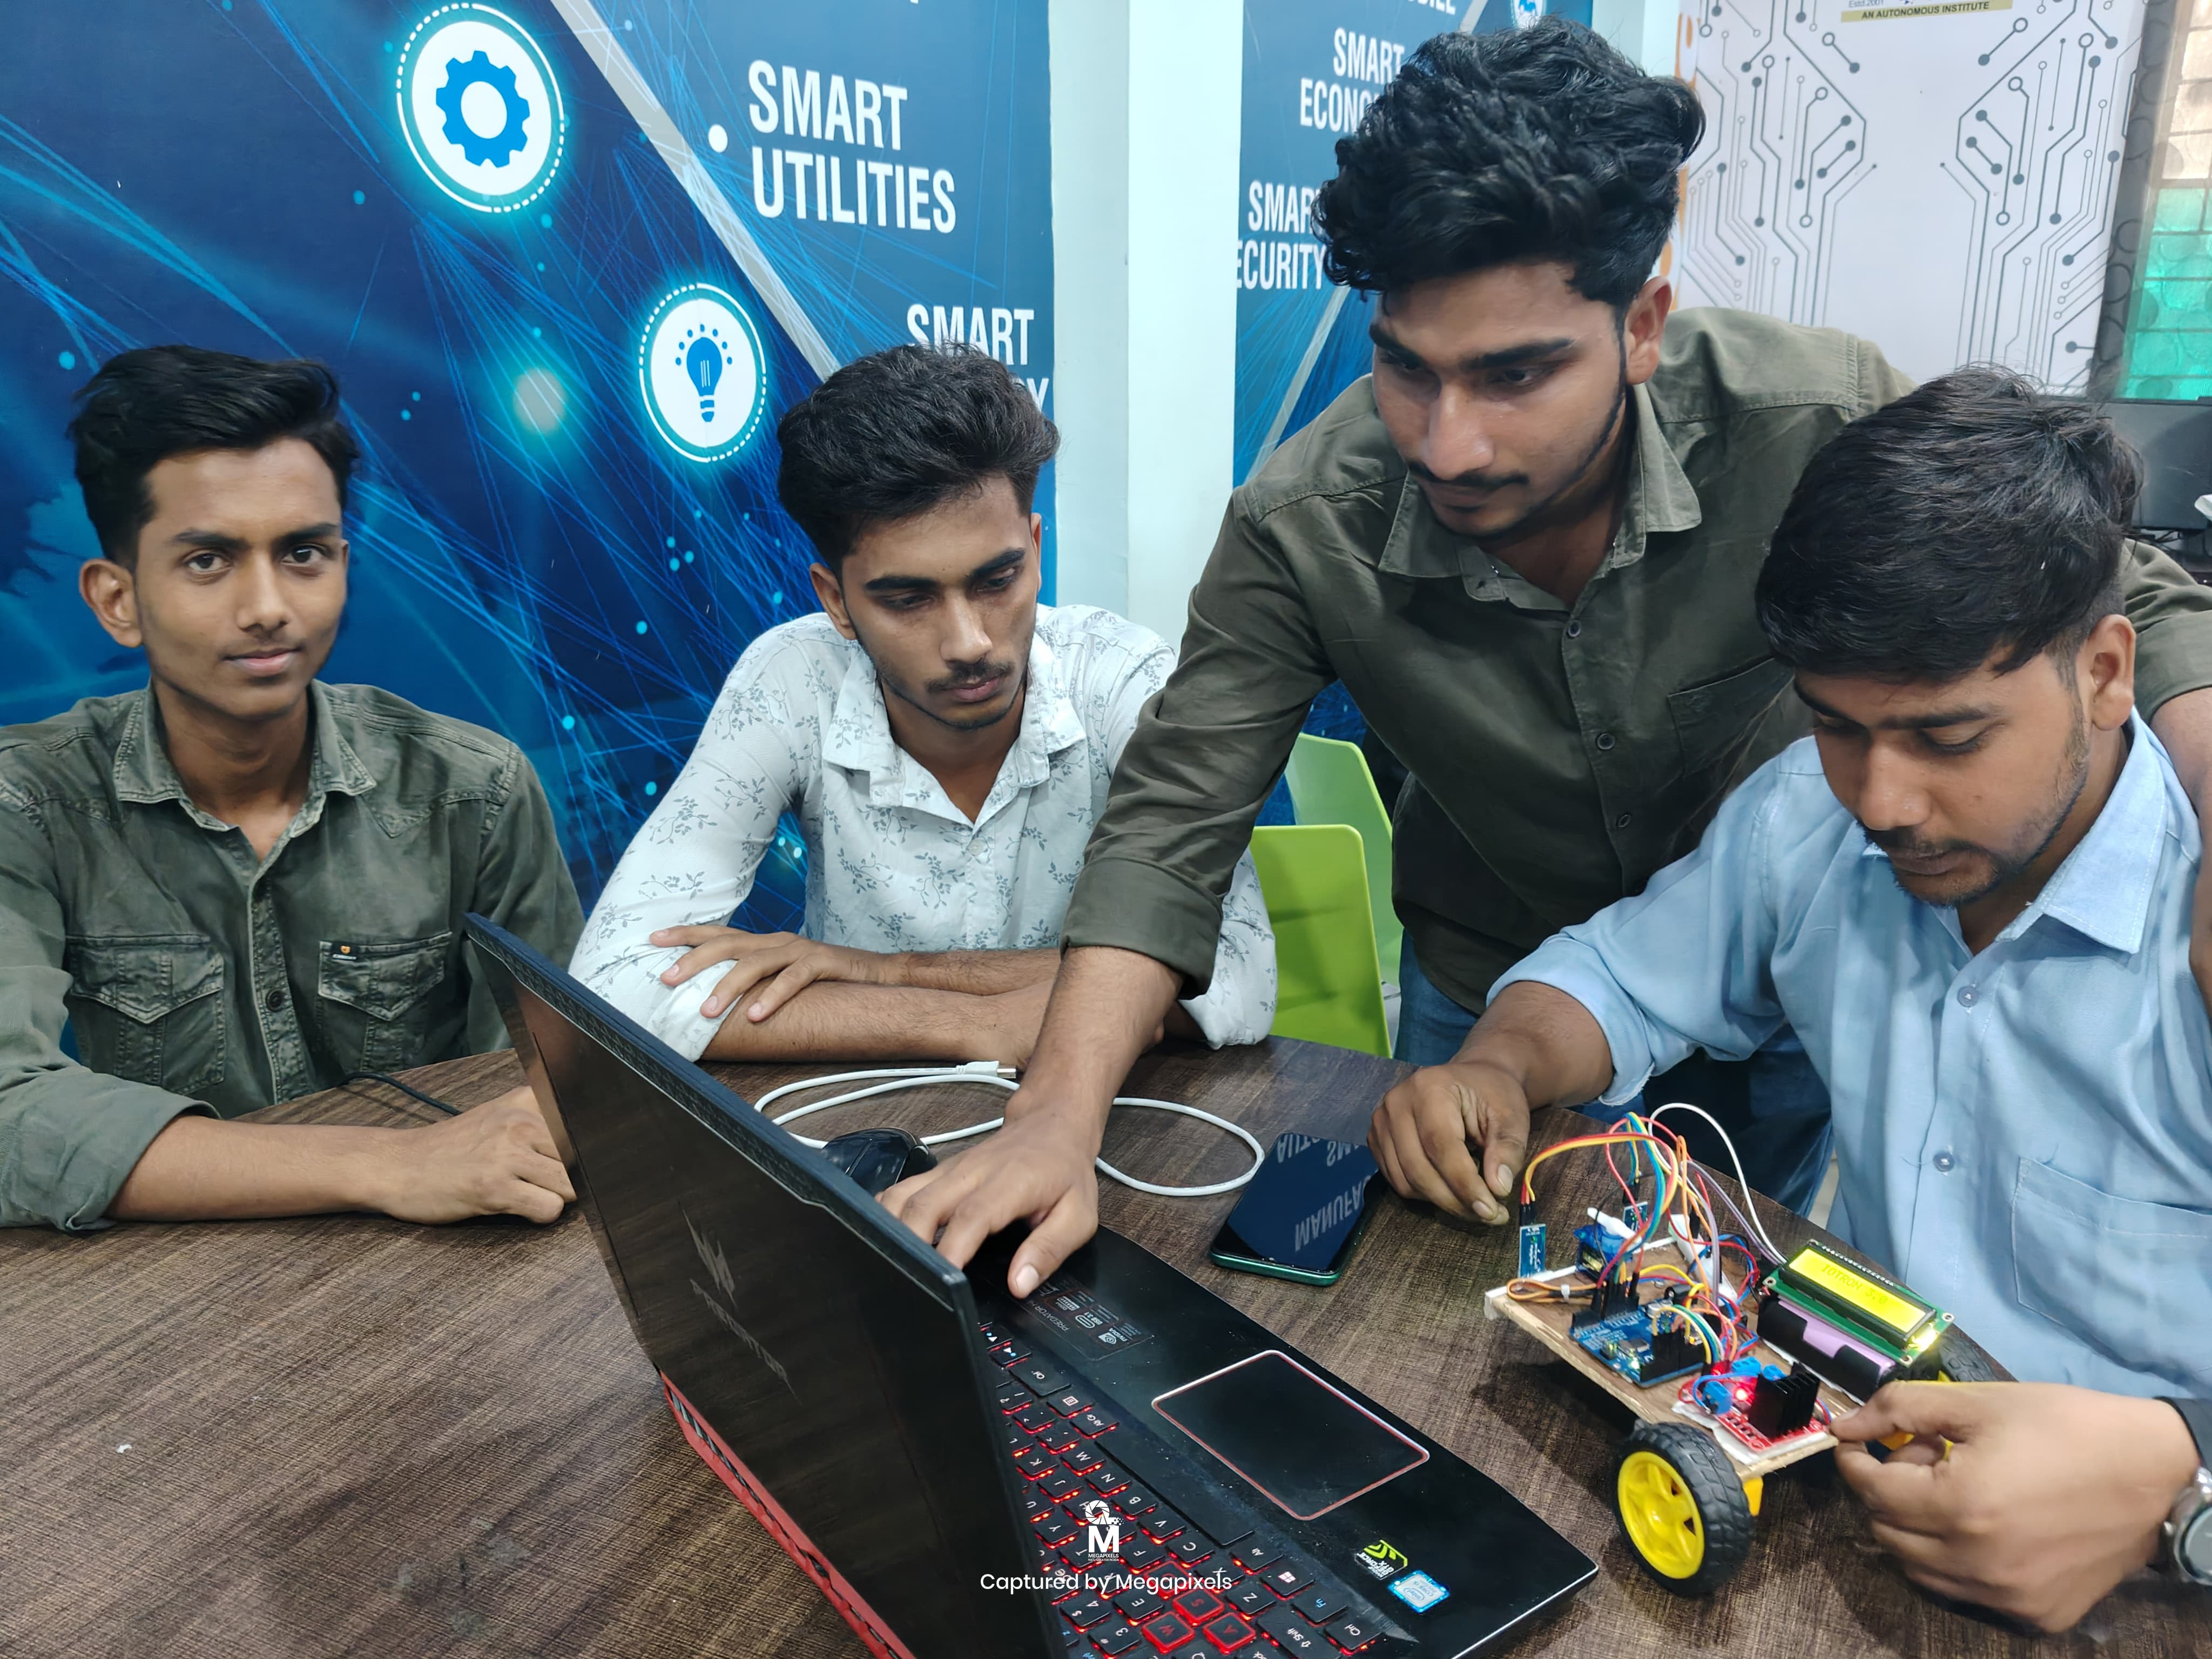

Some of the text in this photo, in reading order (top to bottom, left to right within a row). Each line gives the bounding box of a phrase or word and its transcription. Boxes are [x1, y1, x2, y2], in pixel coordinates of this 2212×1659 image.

[1862, 2, 1990, 19] AN AUTONOMOUS INSTITUTE
[1333, 28, 1405, 84] SMART
[748, 60, 907, 151] SMART
[1300, 77, 1380, 133] ECONO
[752, 146, 956, 233] UTILITIES
[1248, 180, 1320, 234] SMAR
[907, 304, 1035, 366] SMART
[1820, 1264, 1888, 1304] IOTRON 3.0
[1035, 1305, 1070, 1331] PREDATOR
[1091, 1316, 1103, 1325] USB
[1029, 1458, 1043, 1466] K
[1076, 1451, 1091, 1462] M
[1101, 1473, 1116, 1482] N
[1026, 1501, 1037, 1509] U
[1129, 1496, 1142, 1505] B
[1182, 1542, 1197, 1551] C
[1378, 1560, 1394, 1573] GTX
[1243, 1593, 1258, 1602] Z
[1407, 1588, 1422, 1601] intel
[1131, 1598, 1145, 1607] E
[1315, 1598, 1326, 1608] Fn
[1115, 1627, 1128, 1637] 3
